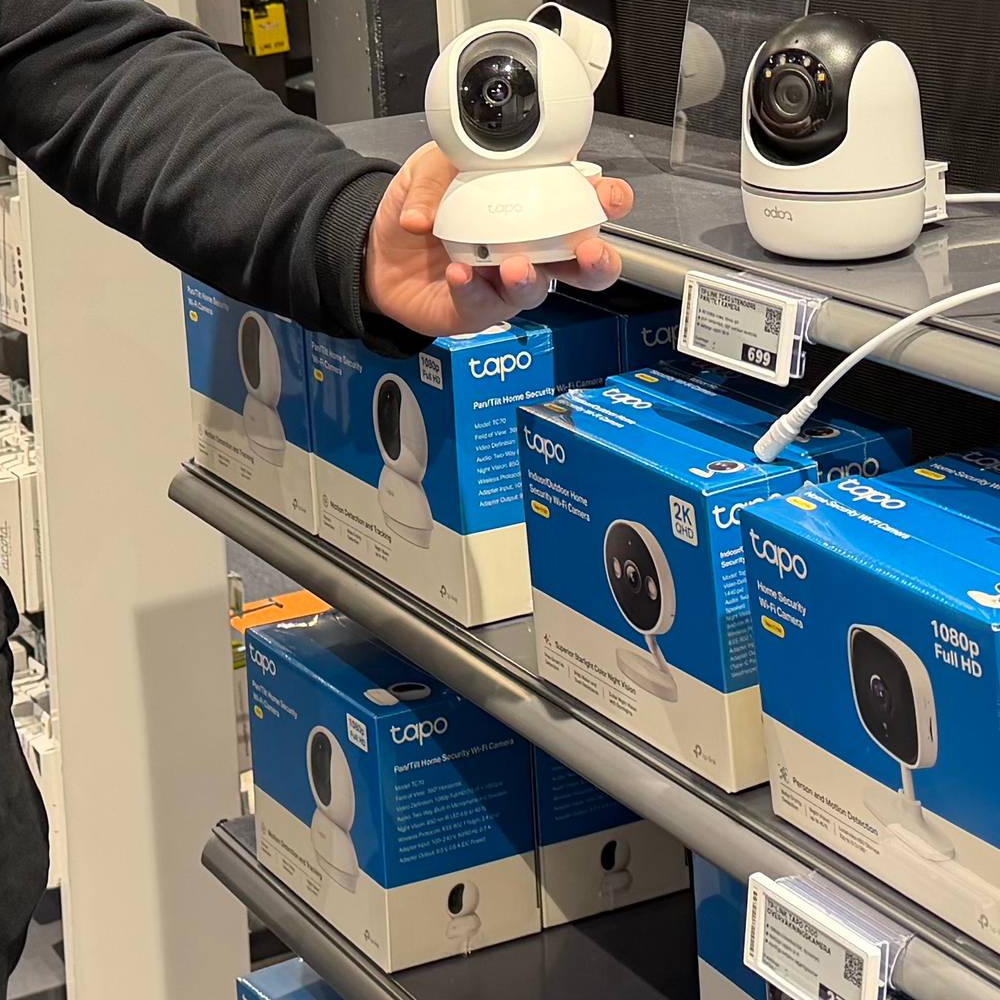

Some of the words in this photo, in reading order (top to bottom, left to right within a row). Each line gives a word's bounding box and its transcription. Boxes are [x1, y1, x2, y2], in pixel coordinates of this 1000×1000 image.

[468, 351, 532, 382] tapo
[747, 347, 771, 367] 699
[473, 395, 502, 411] Pan/Tilt
[502, 391, 524, 405] Home
[524, 385, 555, 402] Security
[602, 388, 653, 409] tapo
[523, 425, 566, 465] tapo
[837, 478, 907, 509] tapo
[567, 501, 590, 522] Camera
[673, 502, 692, 526] 2K
[675, 522, 694, 540] QHD
[749, 528, 808, 580] tapo
[756, 579, 777, 600] Home
[777, 590, 806, 618] Security
[776, 604, 803, 630] Camera
[930, 619, 980, 659] 1080p
[249, 643, 277, 676] tapo
[934, 642, 959, 669] Full
[961, 654, 983, 678] HD
[390, 717, 449, 746] tapo
[420, 754, 441, 767] Home
[441, 747, 470, 763] Security
[488, 736, 514, 751] Camera
[792, 775, 812, 796] Person
[813, 790, 824, 804] and
[825, 796, 846, 817] Motion
[847, 809, 878, 836] Detection
